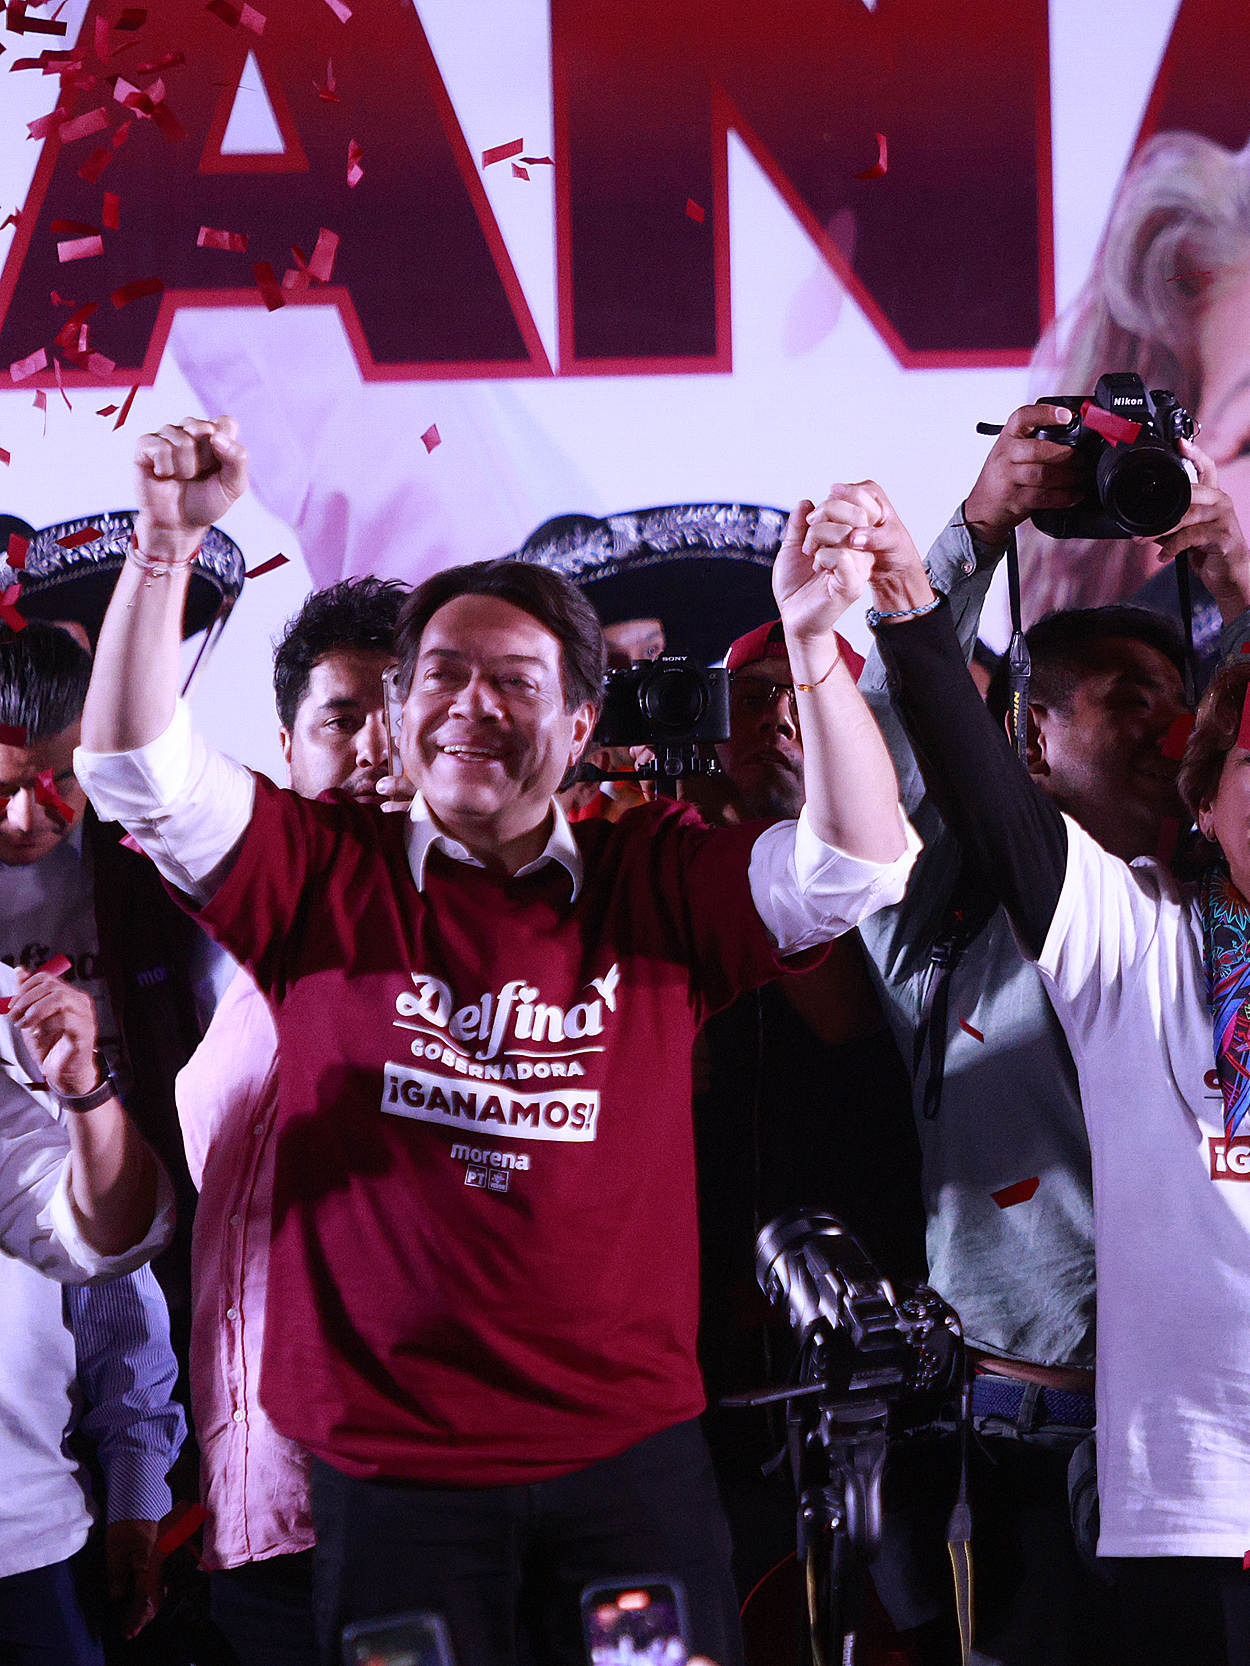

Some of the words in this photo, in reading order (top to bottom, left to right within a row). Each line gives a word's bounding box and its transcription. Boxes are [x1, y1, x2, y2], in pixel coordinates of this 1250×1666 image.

[1113, 396, 1143, 406] Nikon
[395, 972, 604, 1061] Delfina
[410, 1037, 586, 1081] GOBERNADORA
[387, 1075, 595, 1132] ¡GANAMOS!
[450, 1143, 531, 1171] morena
[467, 1171, 485, 1185] PT
